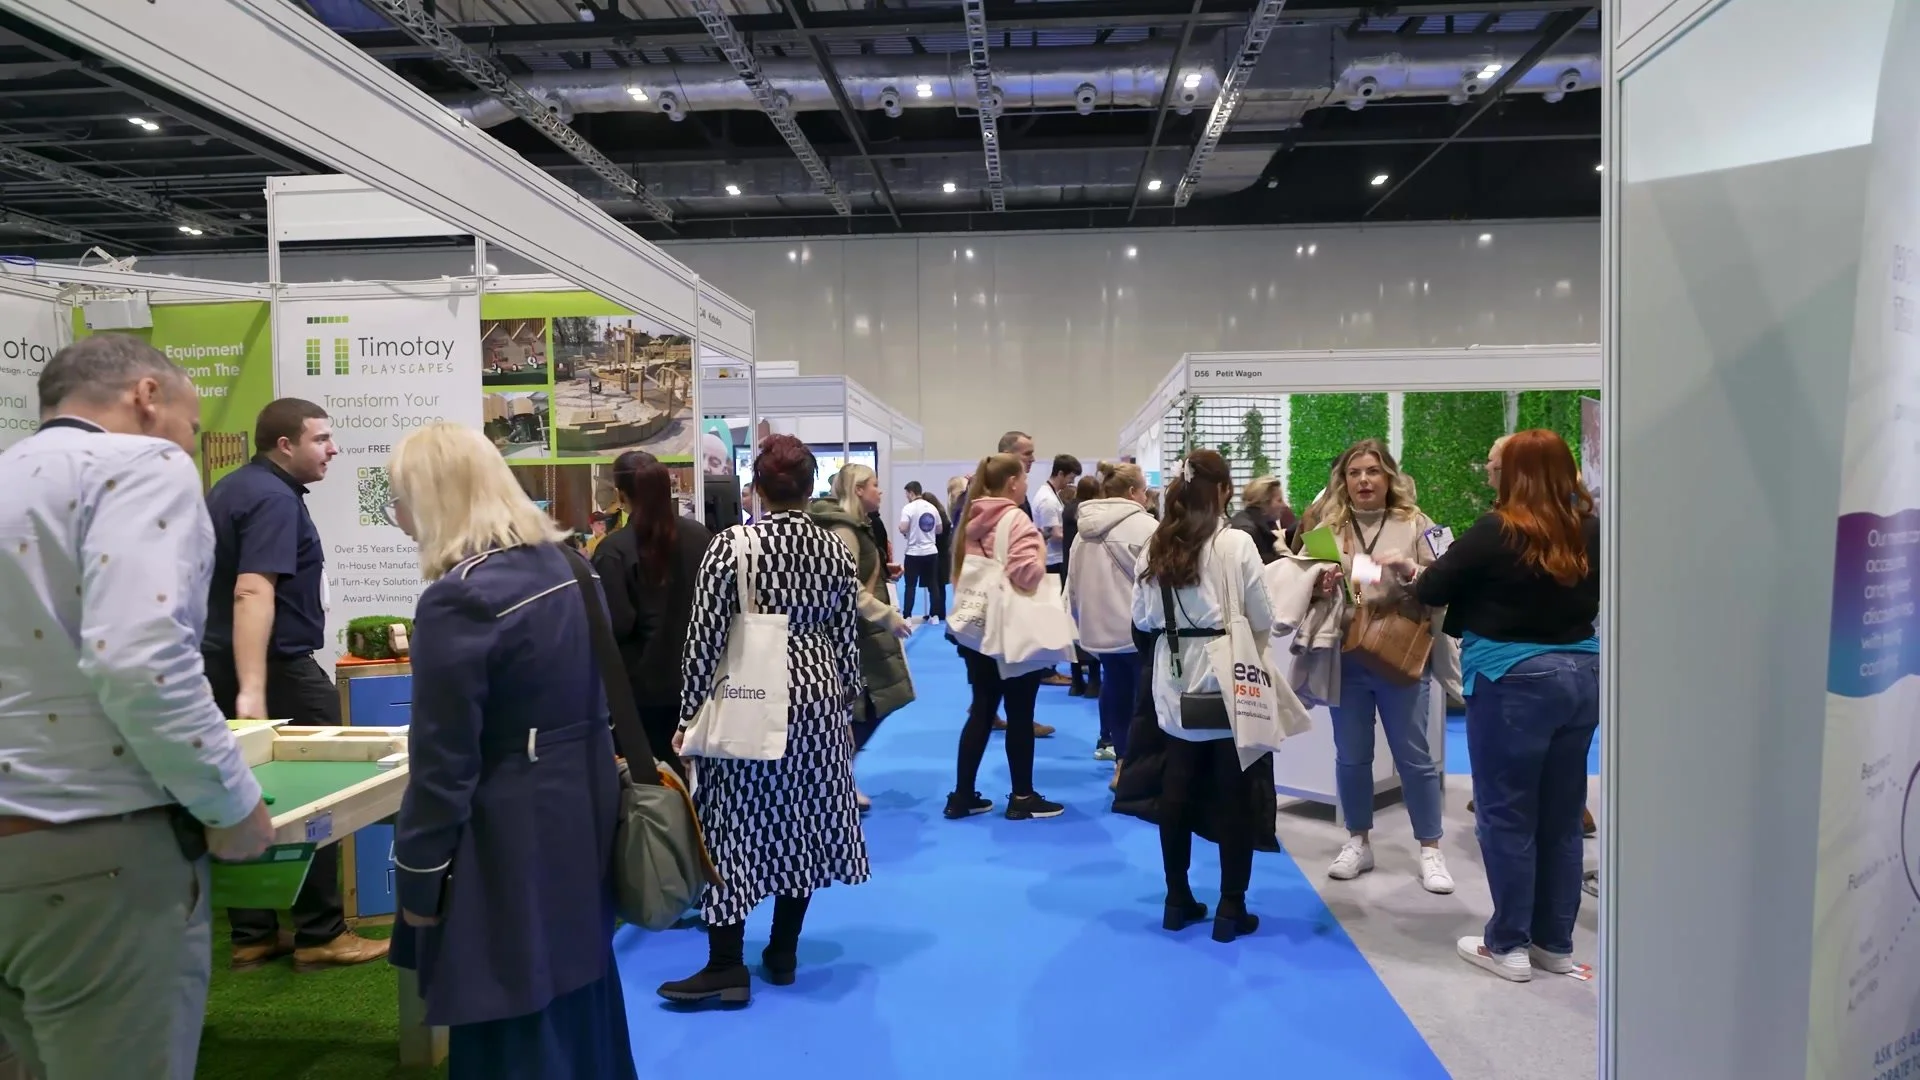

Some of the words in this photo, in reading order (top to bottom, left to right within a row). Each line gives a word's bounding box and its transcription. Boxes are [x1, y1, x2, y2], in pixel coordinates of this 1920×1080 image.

[165, 342, 245, 361] Equipment
[358, 336, 455, 361] Timotay
[186, 366, 211, 377] om
[214, 363, 240, 377] The
[361, 363, 455, 375] PLAYSCAPES
[1194, 370, 1210, 378] D56
[1215, 370, 1234, 378] Petit
[1235, 370, 1263, 378] Wagon
[324, 393, 399, 408] Transform
[404, 392, 440, 407] Your
[367, 444, 391, 453] FREE
[334, 545, 354, 554] Over
[357, 545, 369, 553] 35
[370, 544, 395, 554] Years
[337, 561, 377, 570] In-House
[328, 579, 339, 587] ull
[341, 577, 380, 587] Turn-Key
[383, 577, 418, 587] Solution
[342, 594, 413, 603] Award-Winning
